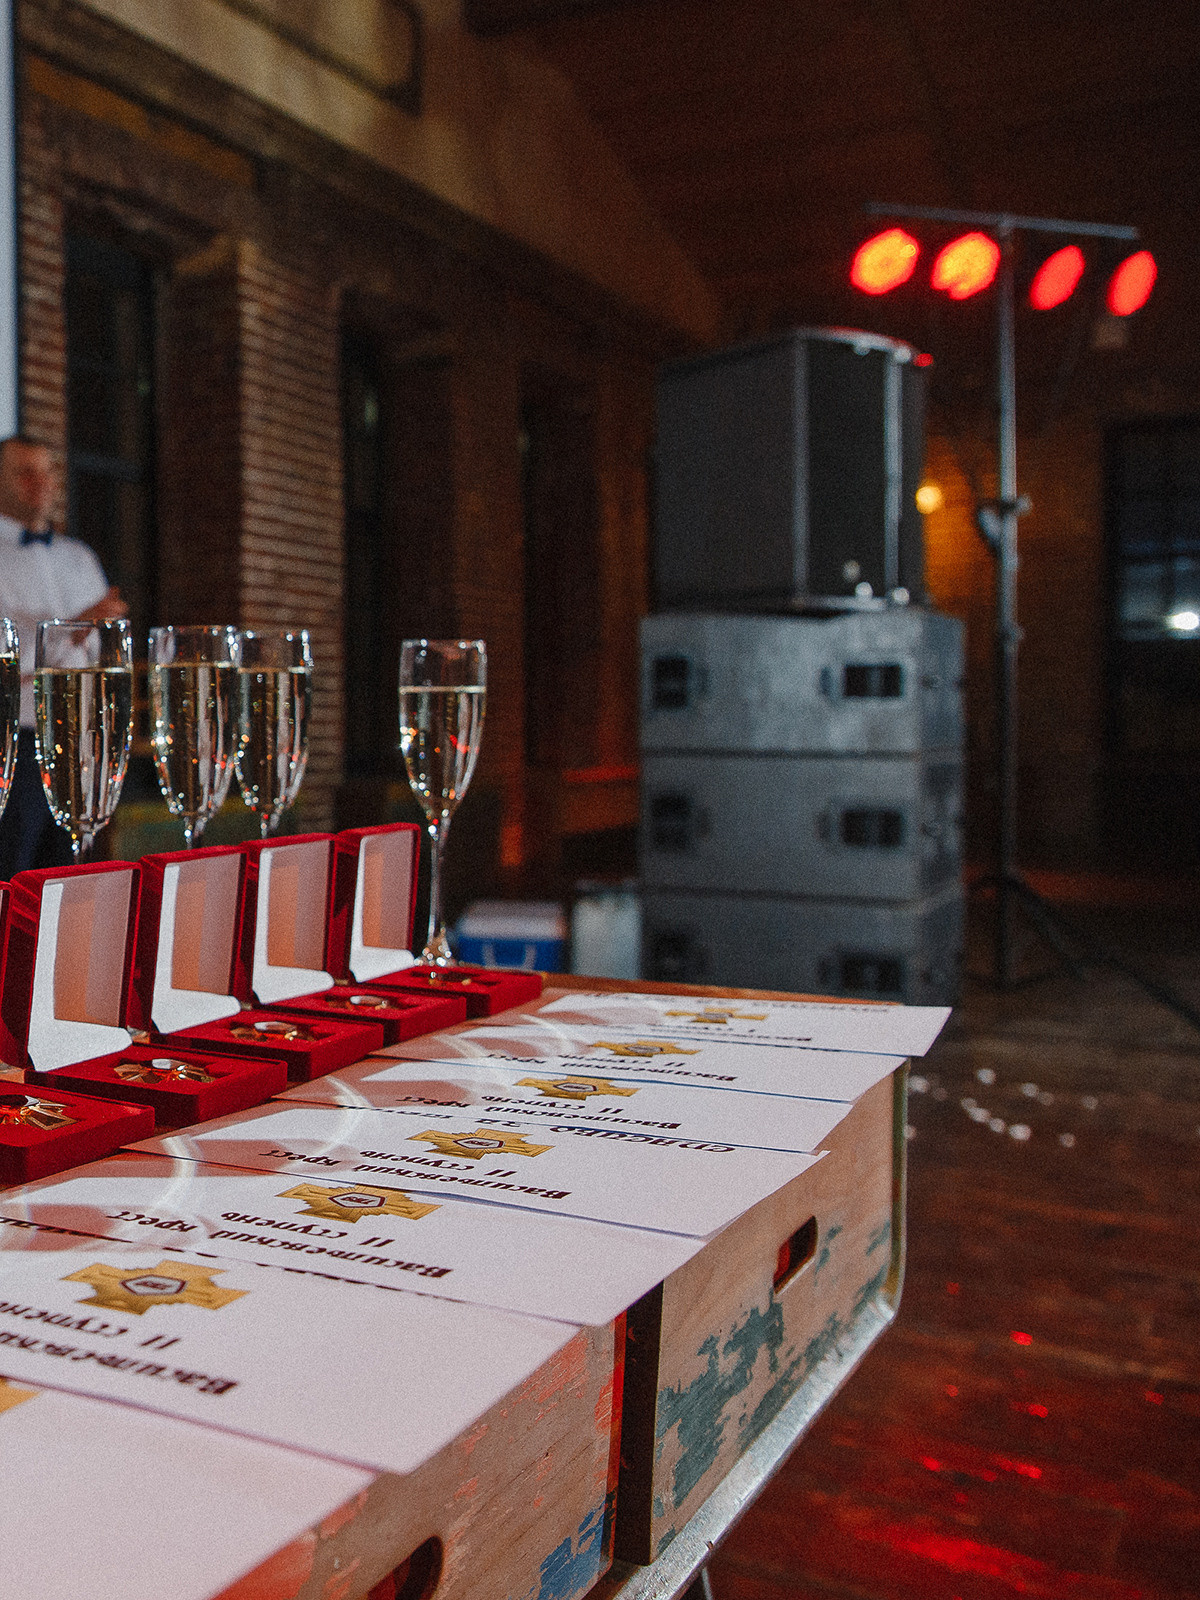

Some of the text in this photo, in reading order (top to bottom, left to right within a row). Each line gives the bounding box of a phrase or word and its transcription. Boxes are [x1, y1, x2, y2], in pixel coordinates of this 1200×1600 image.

[394, 1095, 681, 1129] Васильевский крест
[257, 1148, 572, 1199] Васильевский крест
[358, 1149, 517, 1177] II ступень
[103, 1210, 197, 1234] крест
[219, 1210, 394, 1247] II ступень
[207, 1227, 453, 1278] Васильевский
[137, 1334, 180, 1350] II
